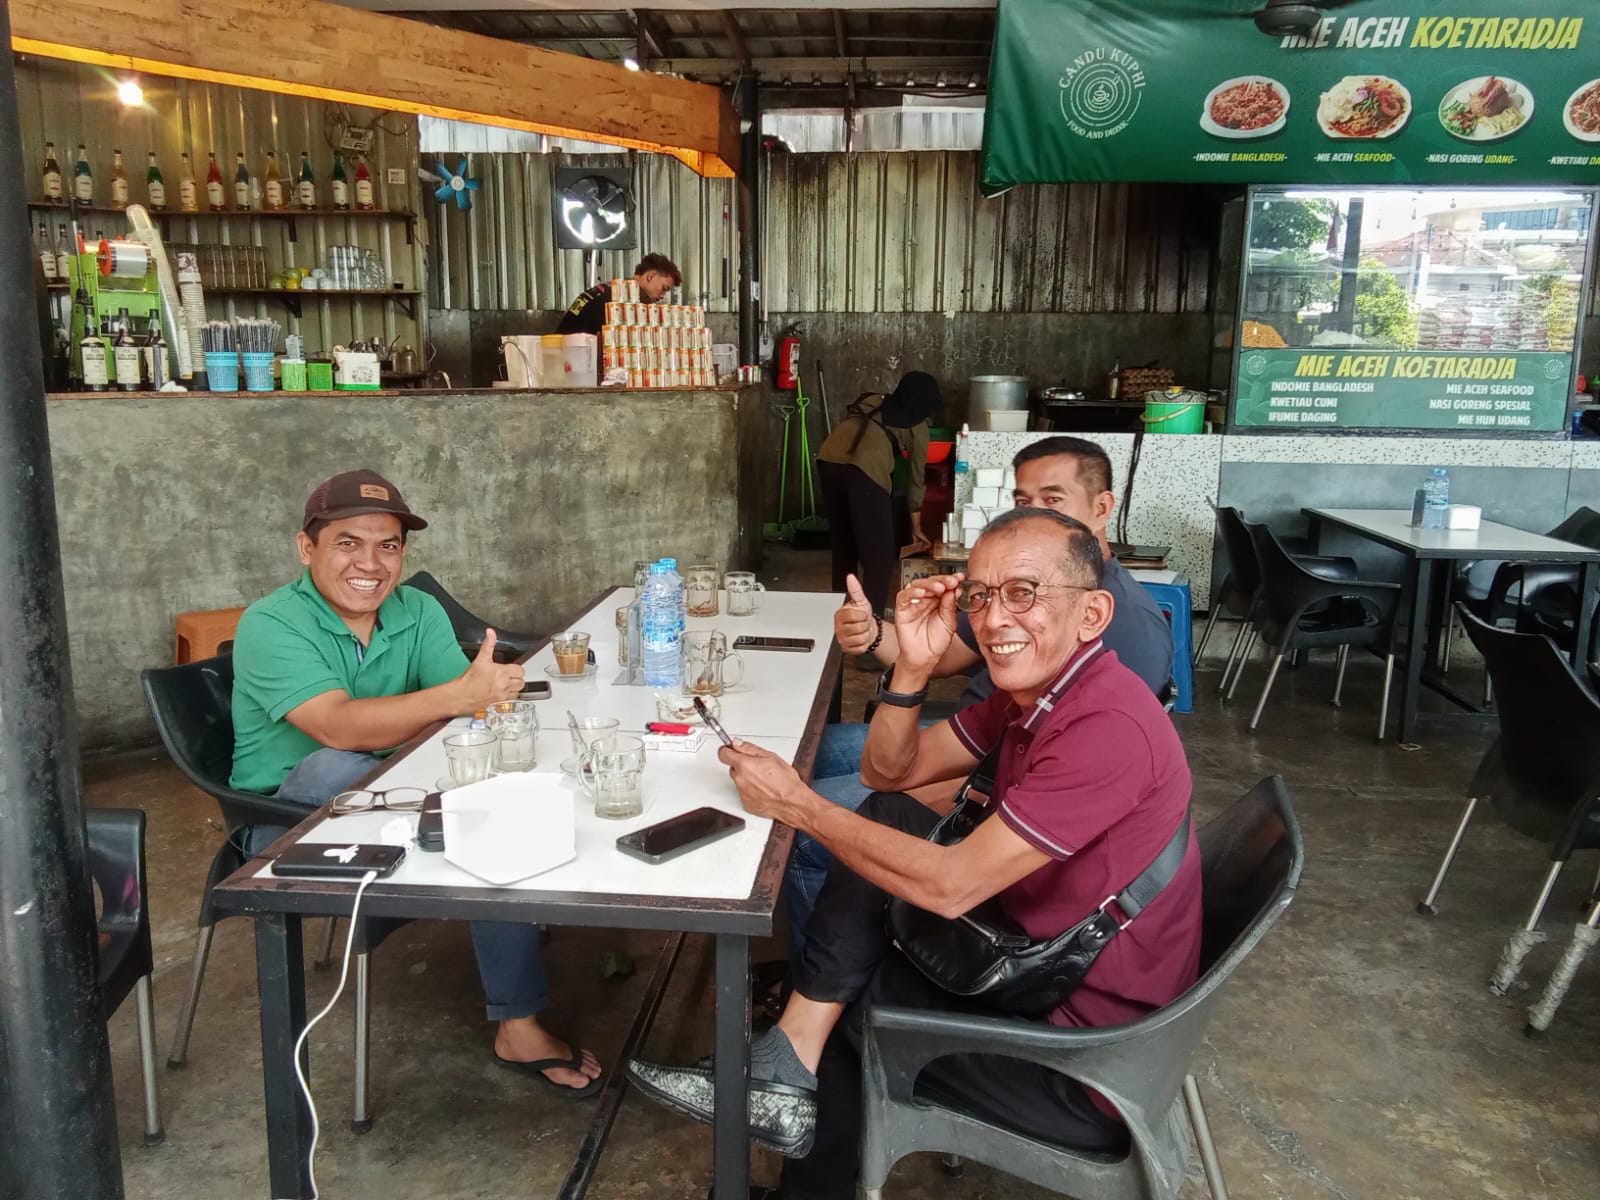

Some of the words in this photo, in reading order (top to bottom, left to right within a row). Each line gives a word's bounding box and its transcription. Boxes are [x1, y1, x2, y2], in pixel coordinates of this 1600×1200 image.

[1336, 17, 1410, 48] ACEH
[1410, 17, 1584, 50] KOETARADJA
[1059, 48, 1105, 89] CANDU
[1110, 48, 1146, 89] KUPHI
[1067, 120, 1086, 136] FOOD
[1086, 130, 1104, 139] AND
[1105, 120, 1129, 138] DRINK
[1331, 153, 1353, 162] ACEH
[1449, 154, 1483, 164] GORENG
[1294, 355, 1335, 377] MIE
[1335, 355, 1390, 378] ACEH
[1391, 356, 1517, 380] KOETARADJA
[1271, 381, 1310, 392] INDOMIE
[1312, 382, 1375, 393] BANGLADESH
[1446, 384, 1463, 395] MIE
[1464, 384, 1488, 395] ACEH
[1490, 385, 1534, 396] SEAFOOD
[1270, 397, 1313, 407] KWETIAU
[1314, 397, 1338, 407] CUMI
[1429, 399, 1451, 410] NASI
[1453, 400, 1492, 410] GORENG
[1494, 400, 1531, 411] SPESIAL
[1268, 412, 1300, 422] IFUMIE
[1301, 412, 1337, 422] DAGING
[1457, 415, 1474, 425] MIE
[1475, 415, 1495, 425] HUN
[1497, 415, 1531, 426] UDANG
